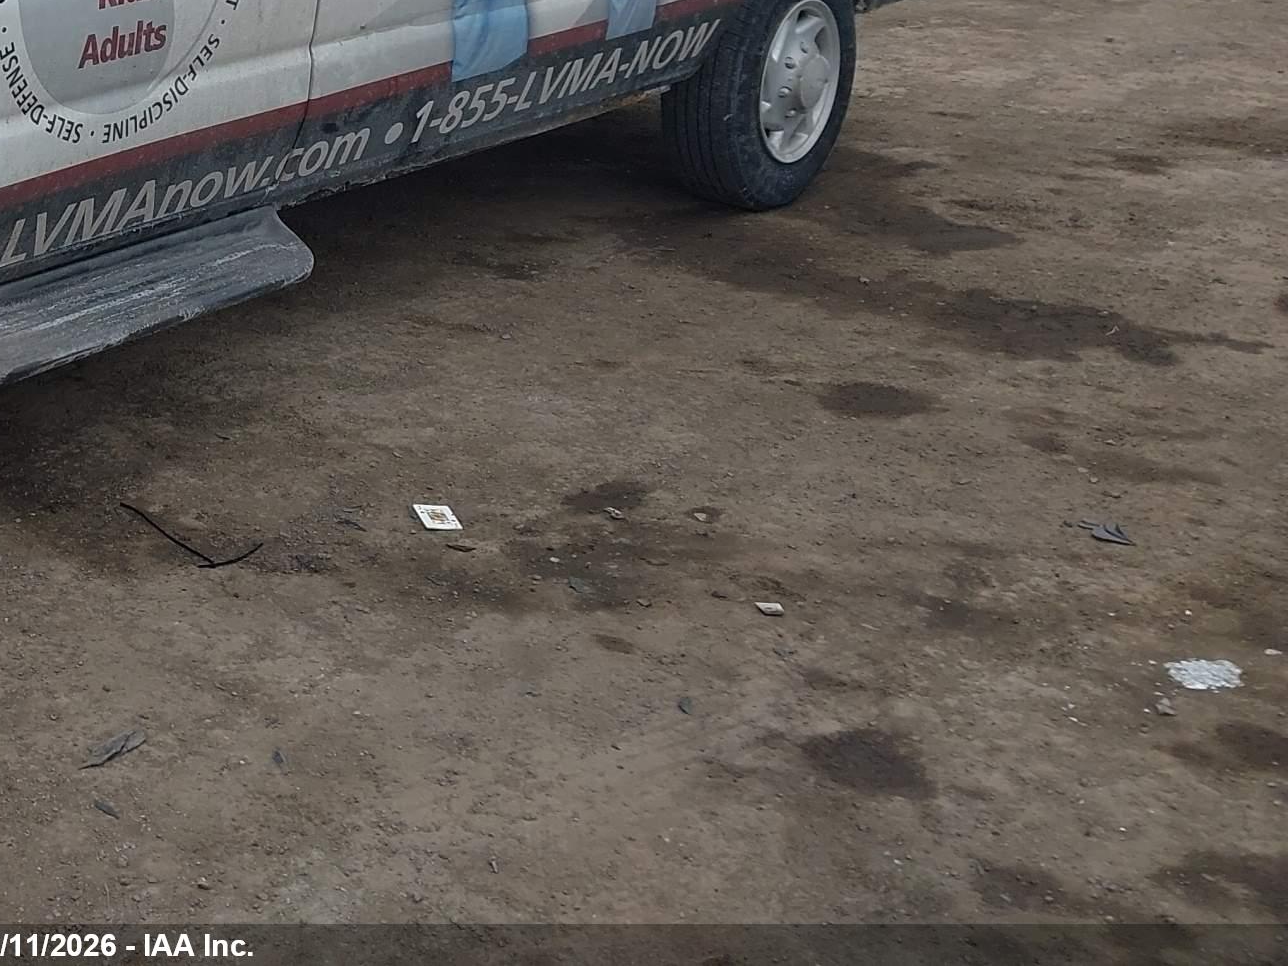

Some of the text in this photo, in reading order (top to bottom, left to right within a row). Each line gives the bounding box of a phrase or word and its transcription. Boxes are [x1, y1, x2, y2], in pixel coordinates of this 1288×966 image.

[77, 20, 167, 70] Adults
[102, 33, 221, 144] SELF-DISCIPLINE
[2, 18, 720, 266] LVMAnow.com 1-855-LVMA-NOW
